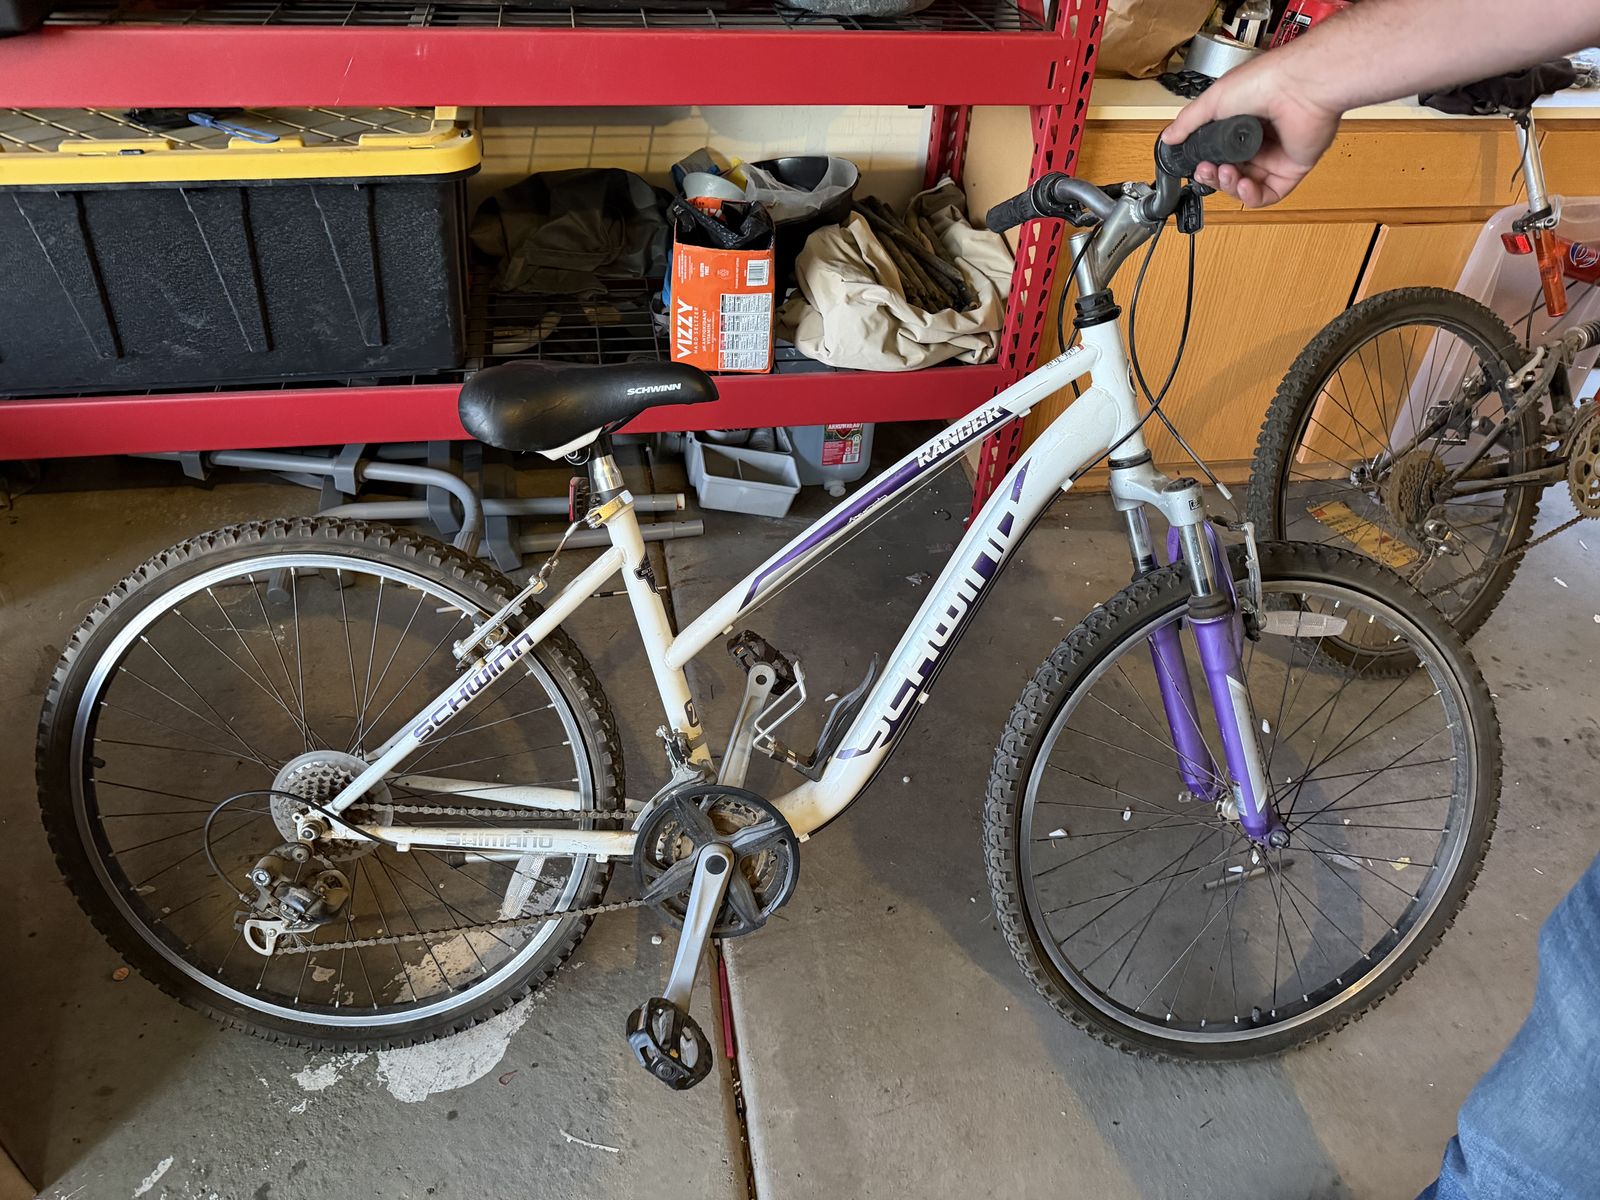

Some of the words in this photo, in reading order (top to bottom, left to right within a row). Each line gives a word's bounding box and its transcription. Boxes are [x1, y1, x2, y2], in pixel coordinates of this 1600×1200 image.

[677, 297, 693, 359] VIZZY
[627, 383, 682, 396] SCHWINN
[414, 633, 534, 742] SCHWINN
[446, 833, 553, 848] SHIMANO
